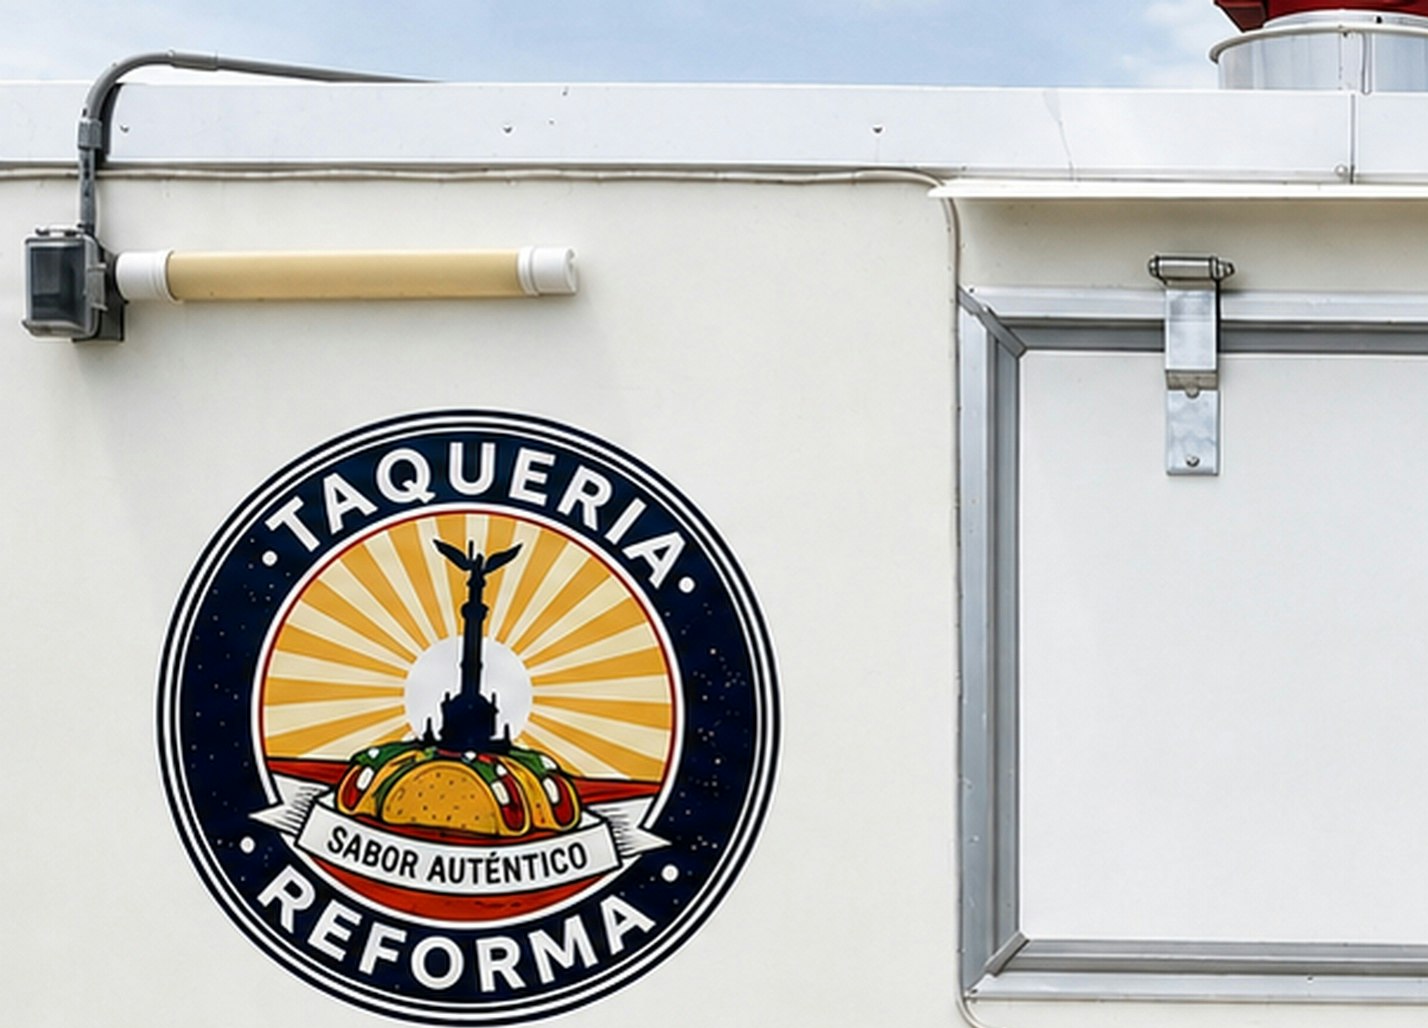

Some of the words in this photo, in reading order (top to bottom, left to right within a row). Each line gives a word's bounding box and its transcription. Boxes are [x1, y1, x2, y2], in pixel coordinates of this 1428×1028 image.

[265, 441, 688, 589] TAQUERIA
[326, 826, 418, 880] SABOR
[427, 842, 589, 886] AUTÉNTICO
[257, 863, 657, 993] REFORMA
